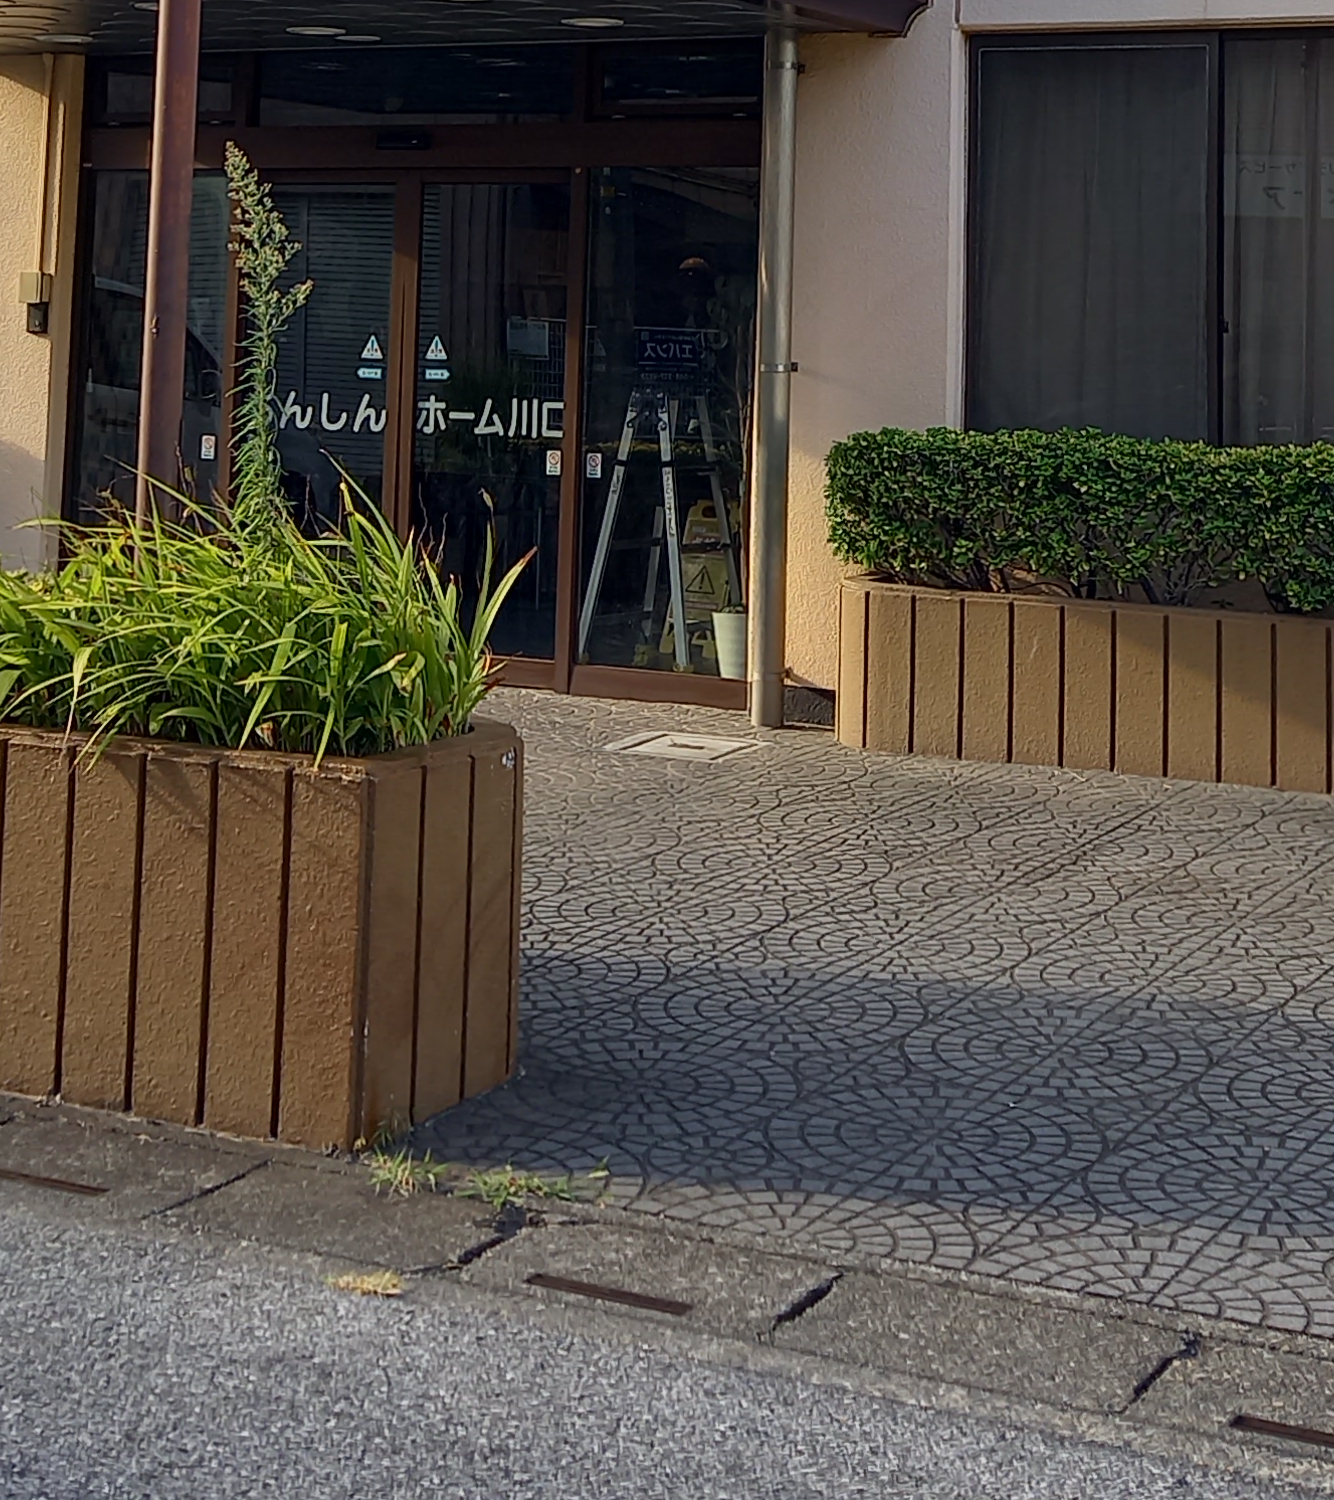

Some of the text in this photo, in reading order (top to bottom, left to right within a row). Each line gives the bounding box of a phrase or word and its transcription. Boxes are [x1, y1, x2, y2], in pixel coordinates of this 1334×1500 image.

[278, 390, 565, 439] んしん ホーム川口
